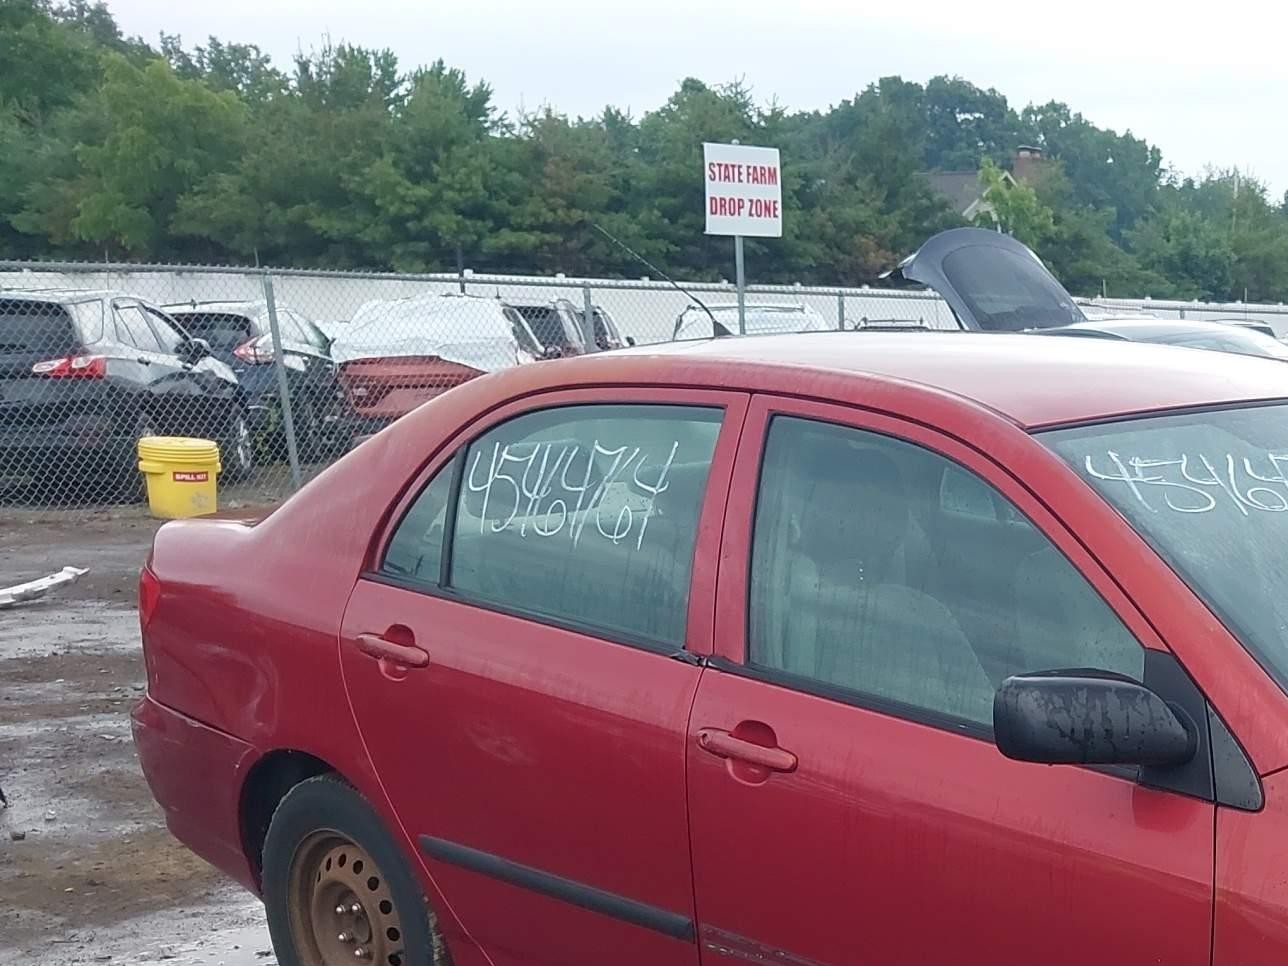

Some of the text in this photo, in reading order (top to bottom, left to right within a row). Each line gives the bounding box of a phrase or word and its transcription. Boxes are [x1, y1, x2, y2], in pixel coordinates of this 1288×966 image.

[708, 162, 778, 185] STATE FARM
[709, 196, 779, 219] DROP ZONE
[468, 439, 679, 551] 45464764
